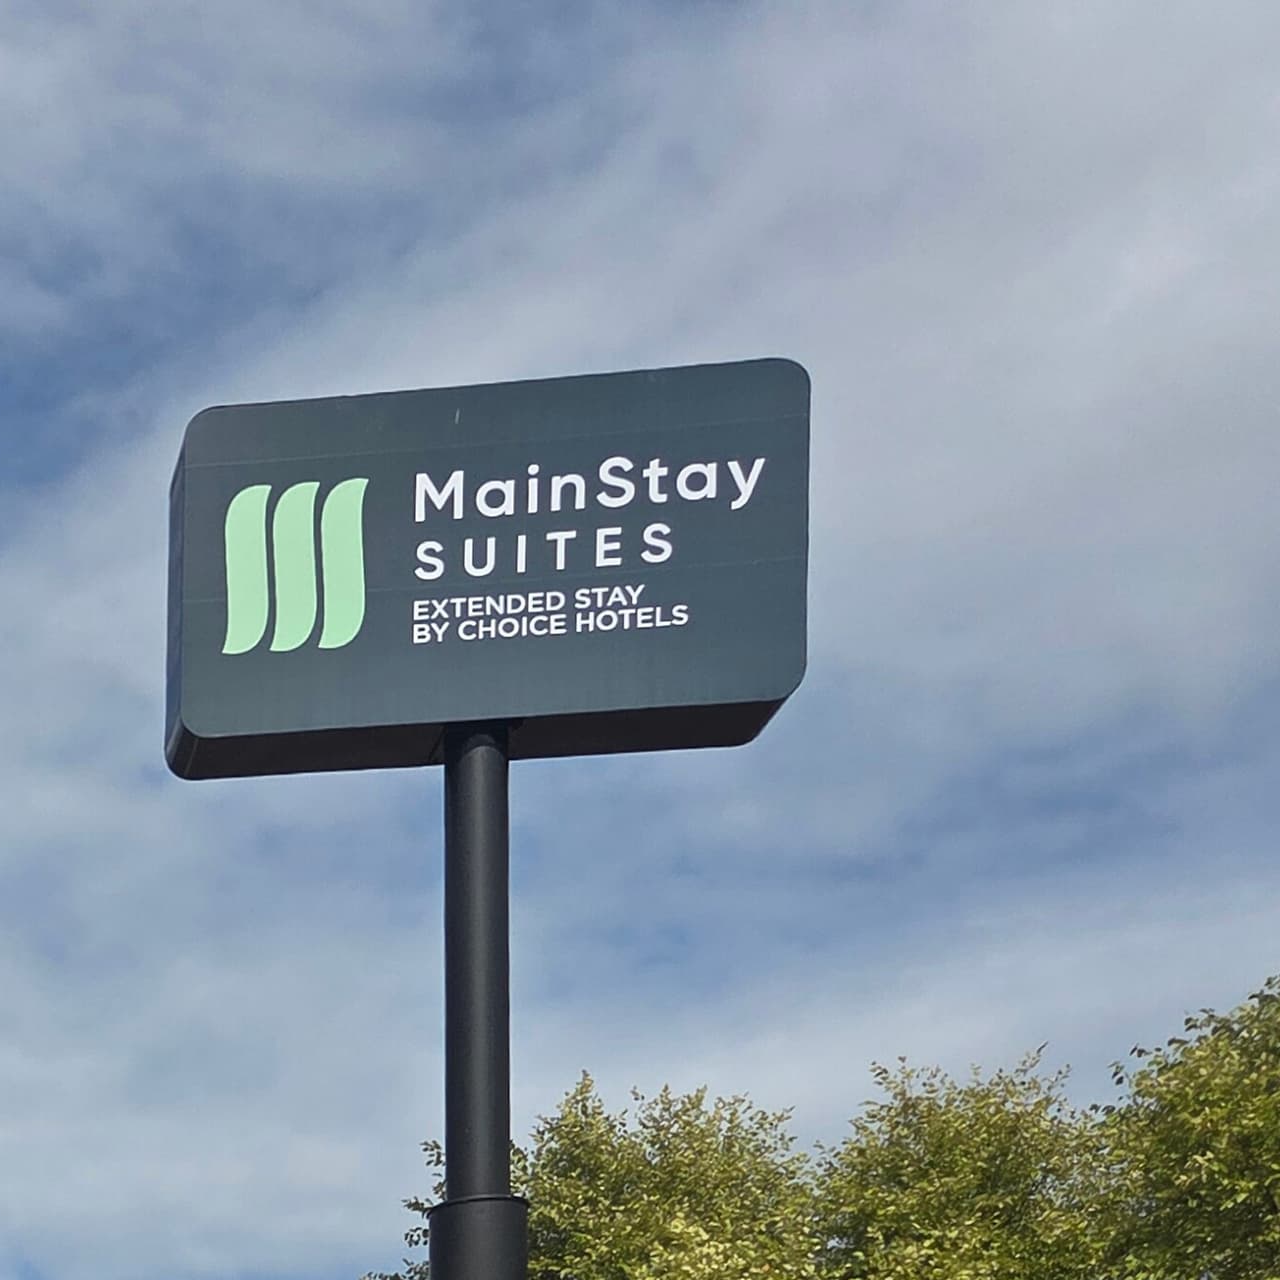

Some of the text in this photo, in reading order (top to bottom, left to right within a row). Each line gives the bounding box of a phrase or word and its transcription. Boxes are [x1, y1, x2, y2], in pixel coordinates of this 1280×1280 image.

[414, 456, 766, 523] MainStay
[414, 522, 673, 580] SUITES
[413, 583, 646, 621] EXTENDED STAY
[413, 604, 689, 644] BY CHOICE HOTELS
